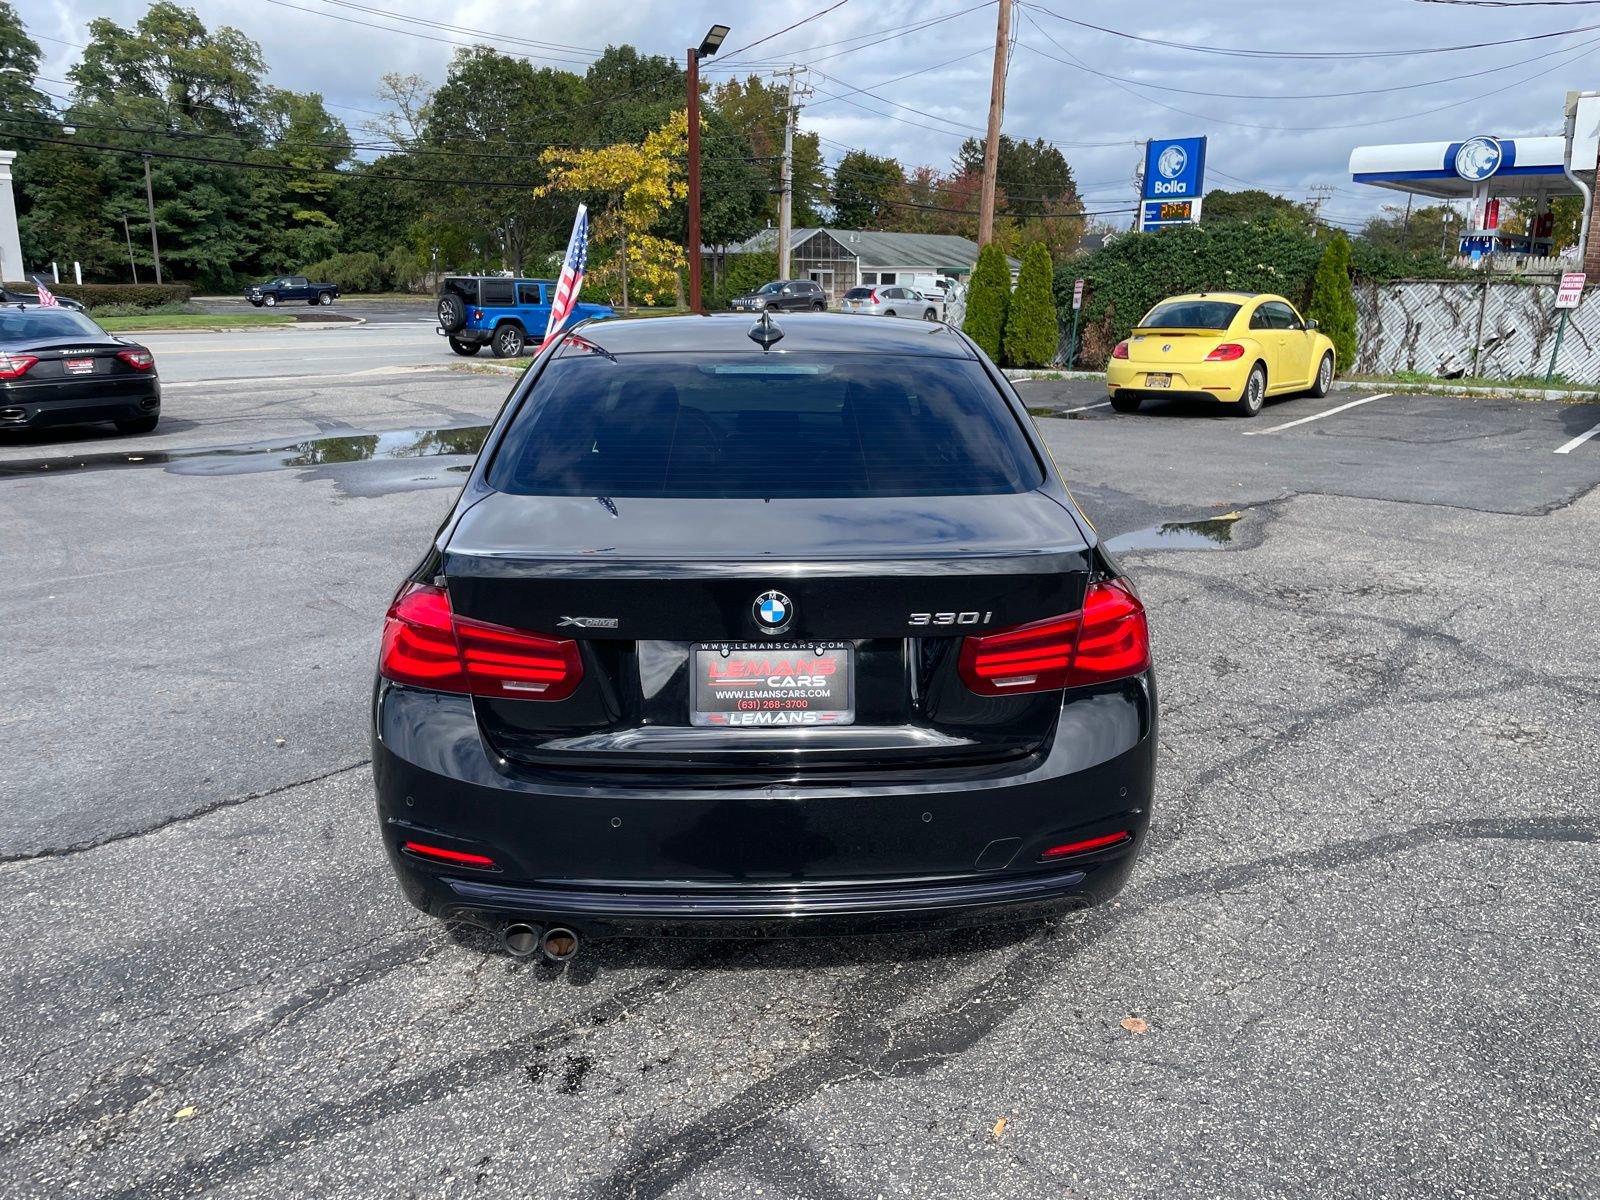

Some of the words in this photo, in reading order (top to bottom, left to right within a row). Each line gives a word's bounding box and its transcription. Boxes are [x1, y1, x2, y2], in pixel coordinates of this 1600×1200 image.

[1154, 180, 1186, 194] Bolla
[756, 593, 790, 605] BMW
[908, 612, 992, 625] 330i
[709, 658, 837, 678] LEMANS
[767, 676, 827, 687] CARS
[715, 690, 831, 699] WWW.LEMANSCARS.COM
[737, 700, 760, 711] (631)
[763, 700, 808, 709] 268-3700
[729, 712, 817, 725] LEMANS
